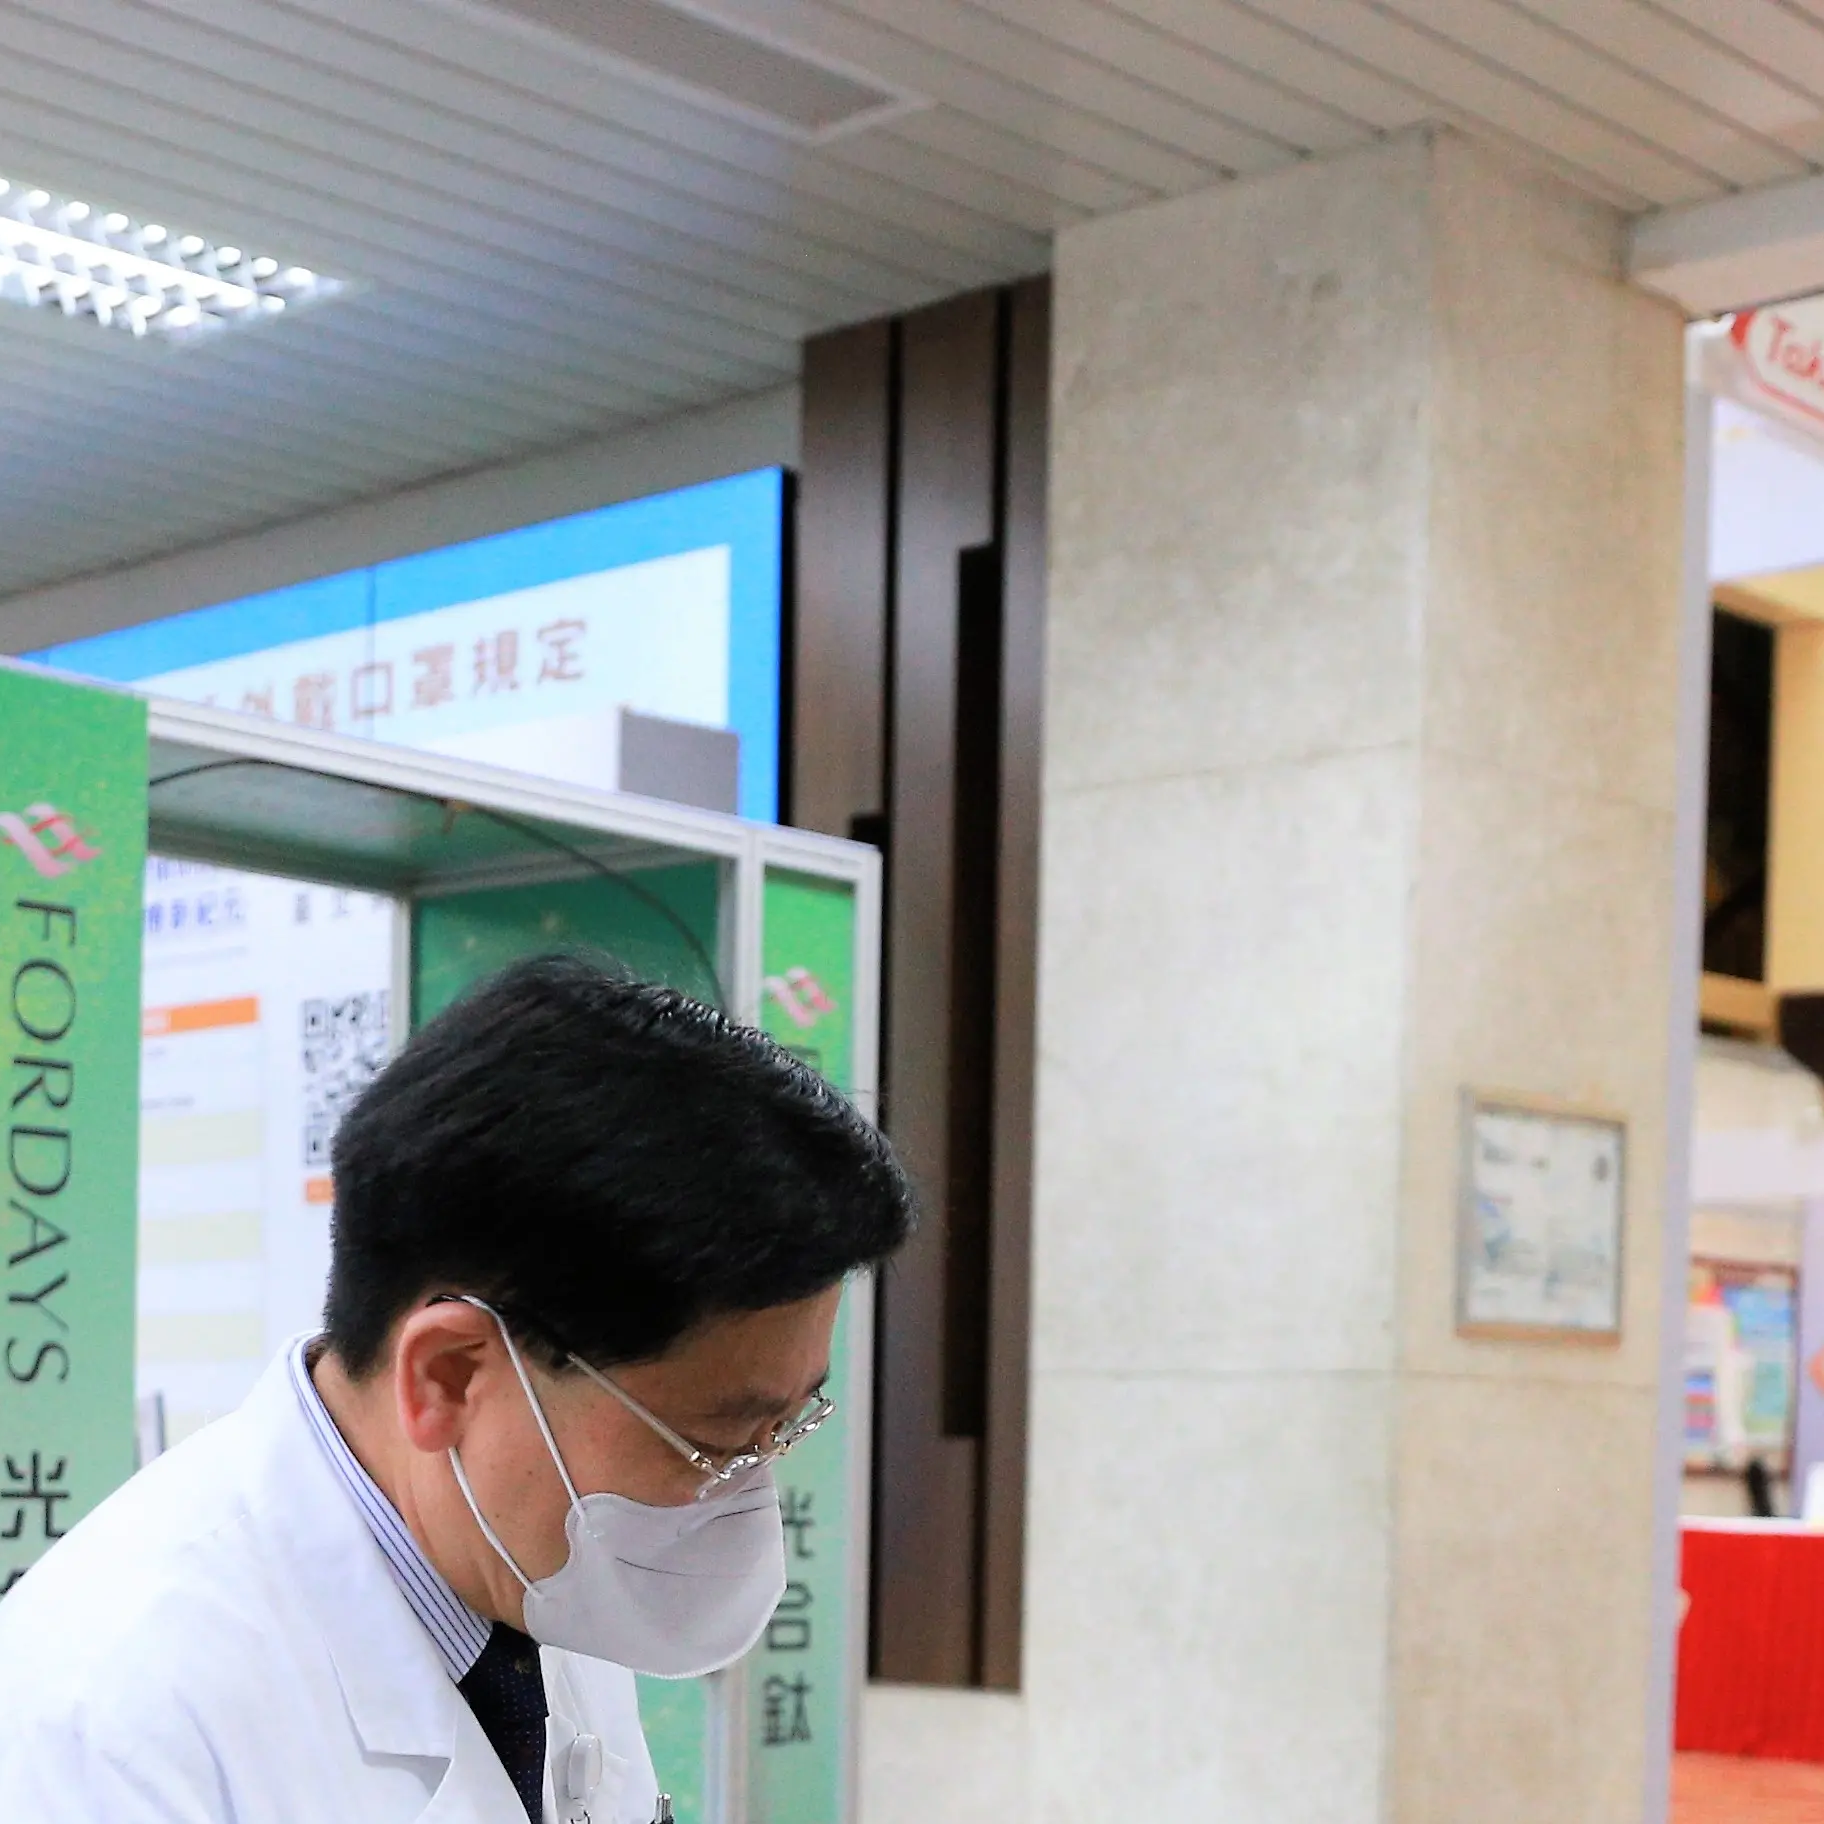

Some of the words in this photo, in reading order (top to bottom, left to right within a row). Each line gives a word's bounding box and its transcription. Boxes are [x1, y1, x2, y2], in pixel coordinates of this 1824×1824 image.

[203, 618, 589, 732] 外戴口罩規定
[1, 898, 77, 1386] FORDAYS
